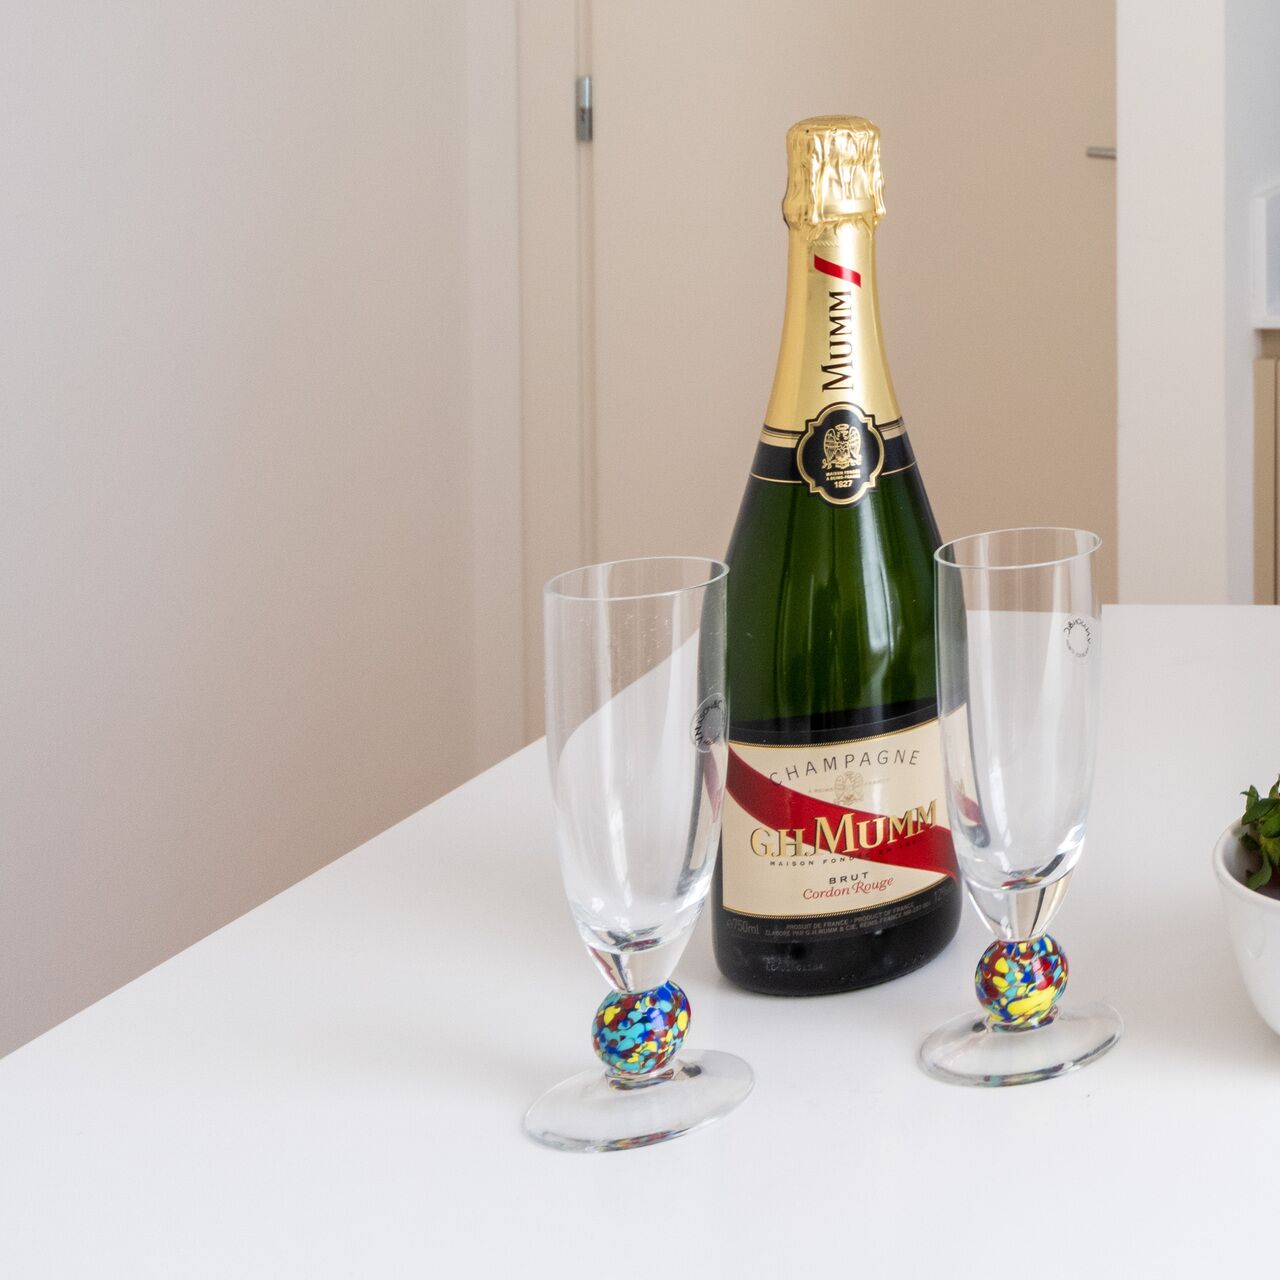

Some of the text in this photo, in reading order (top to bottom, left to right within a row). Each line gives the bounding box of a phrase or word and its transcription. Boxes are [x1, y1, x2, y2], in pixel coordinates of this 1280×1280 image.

[820, 291, 854, 392] MUMM
[834, 480, 853, 488] 1827
[769, 749, 920, 787] CHAMPAGNE
[802, 877, 894, 900] Cordon Rouge
[828, 872, 869, 885] BRUT
